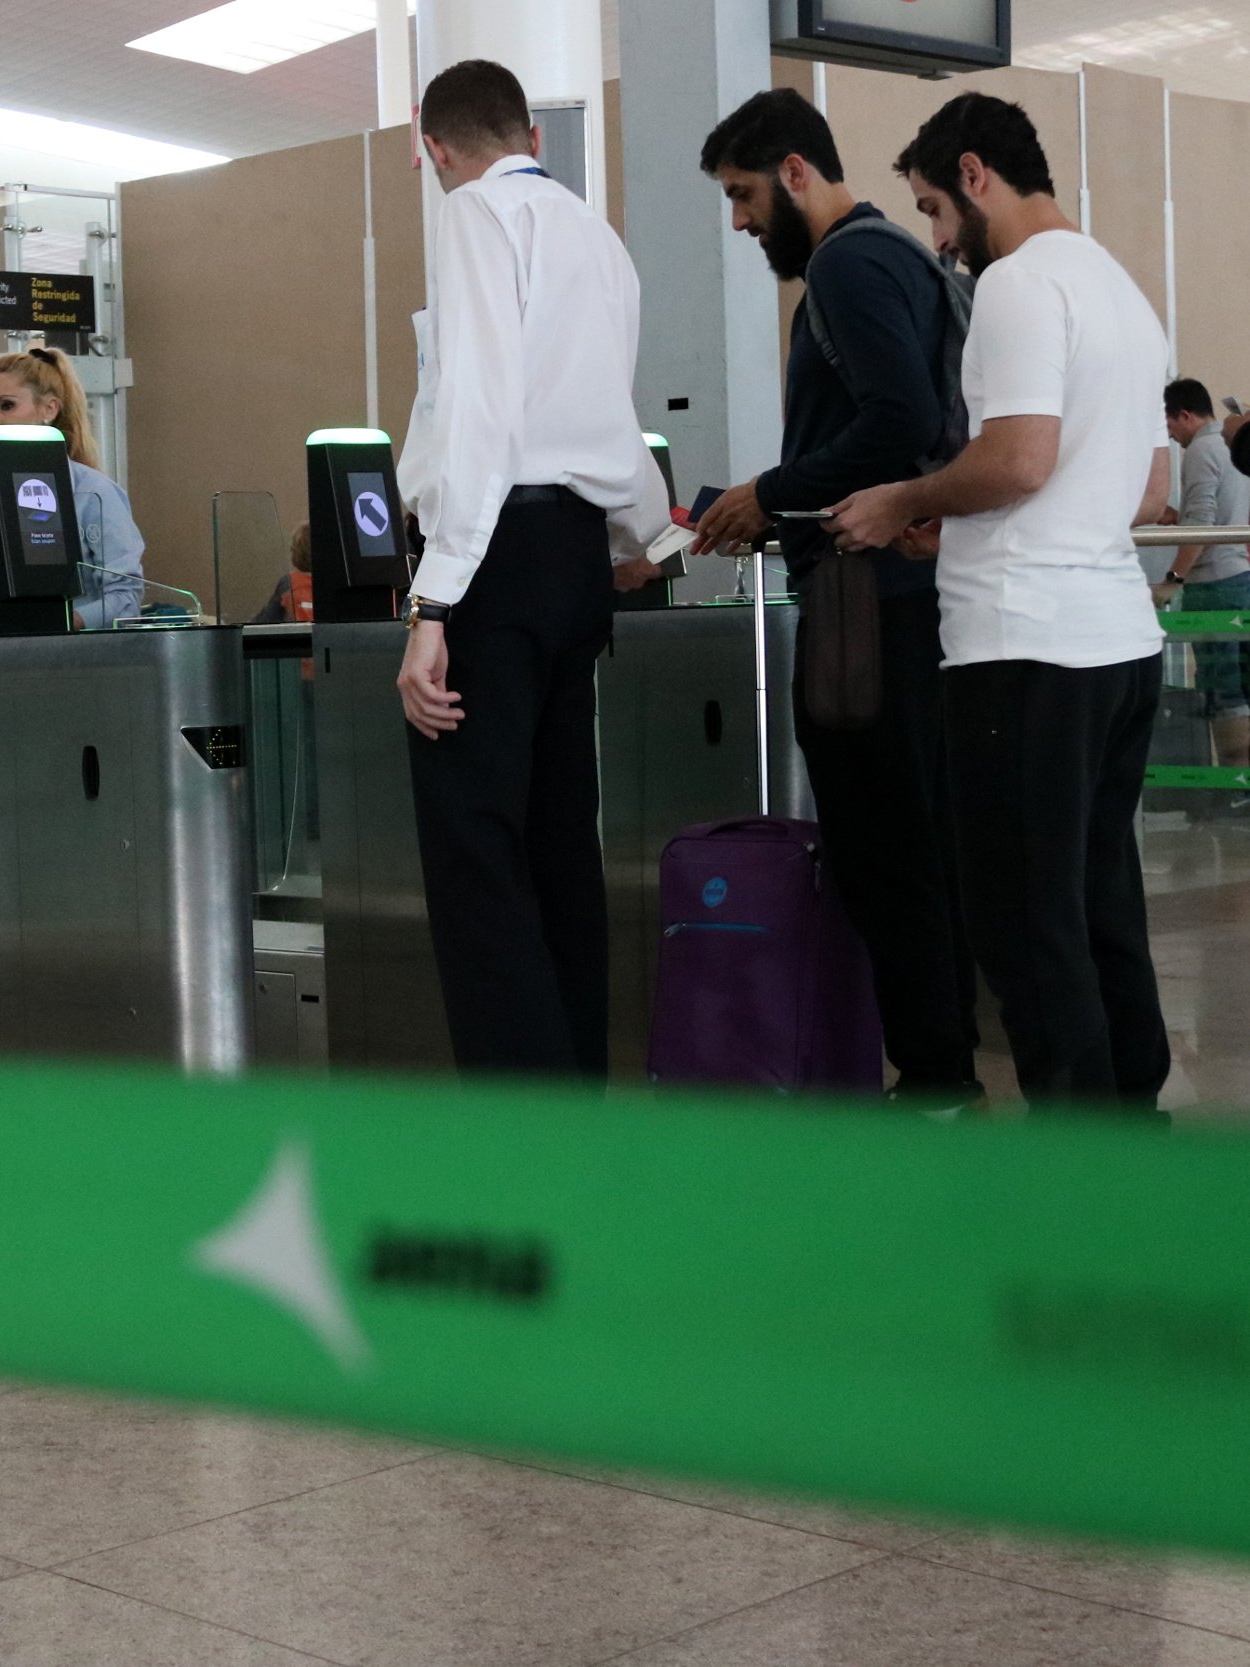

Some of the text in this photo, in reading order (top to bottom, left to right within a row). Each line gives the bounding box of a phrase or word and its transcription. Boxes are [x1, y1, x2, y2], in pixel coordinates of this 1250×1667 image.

[31, 277, 53, 288] Zona
[31, 290, 81, 302] Restringida
[32, 301, 44, 310] de
[33, 312, 77, 323] Seguridad
